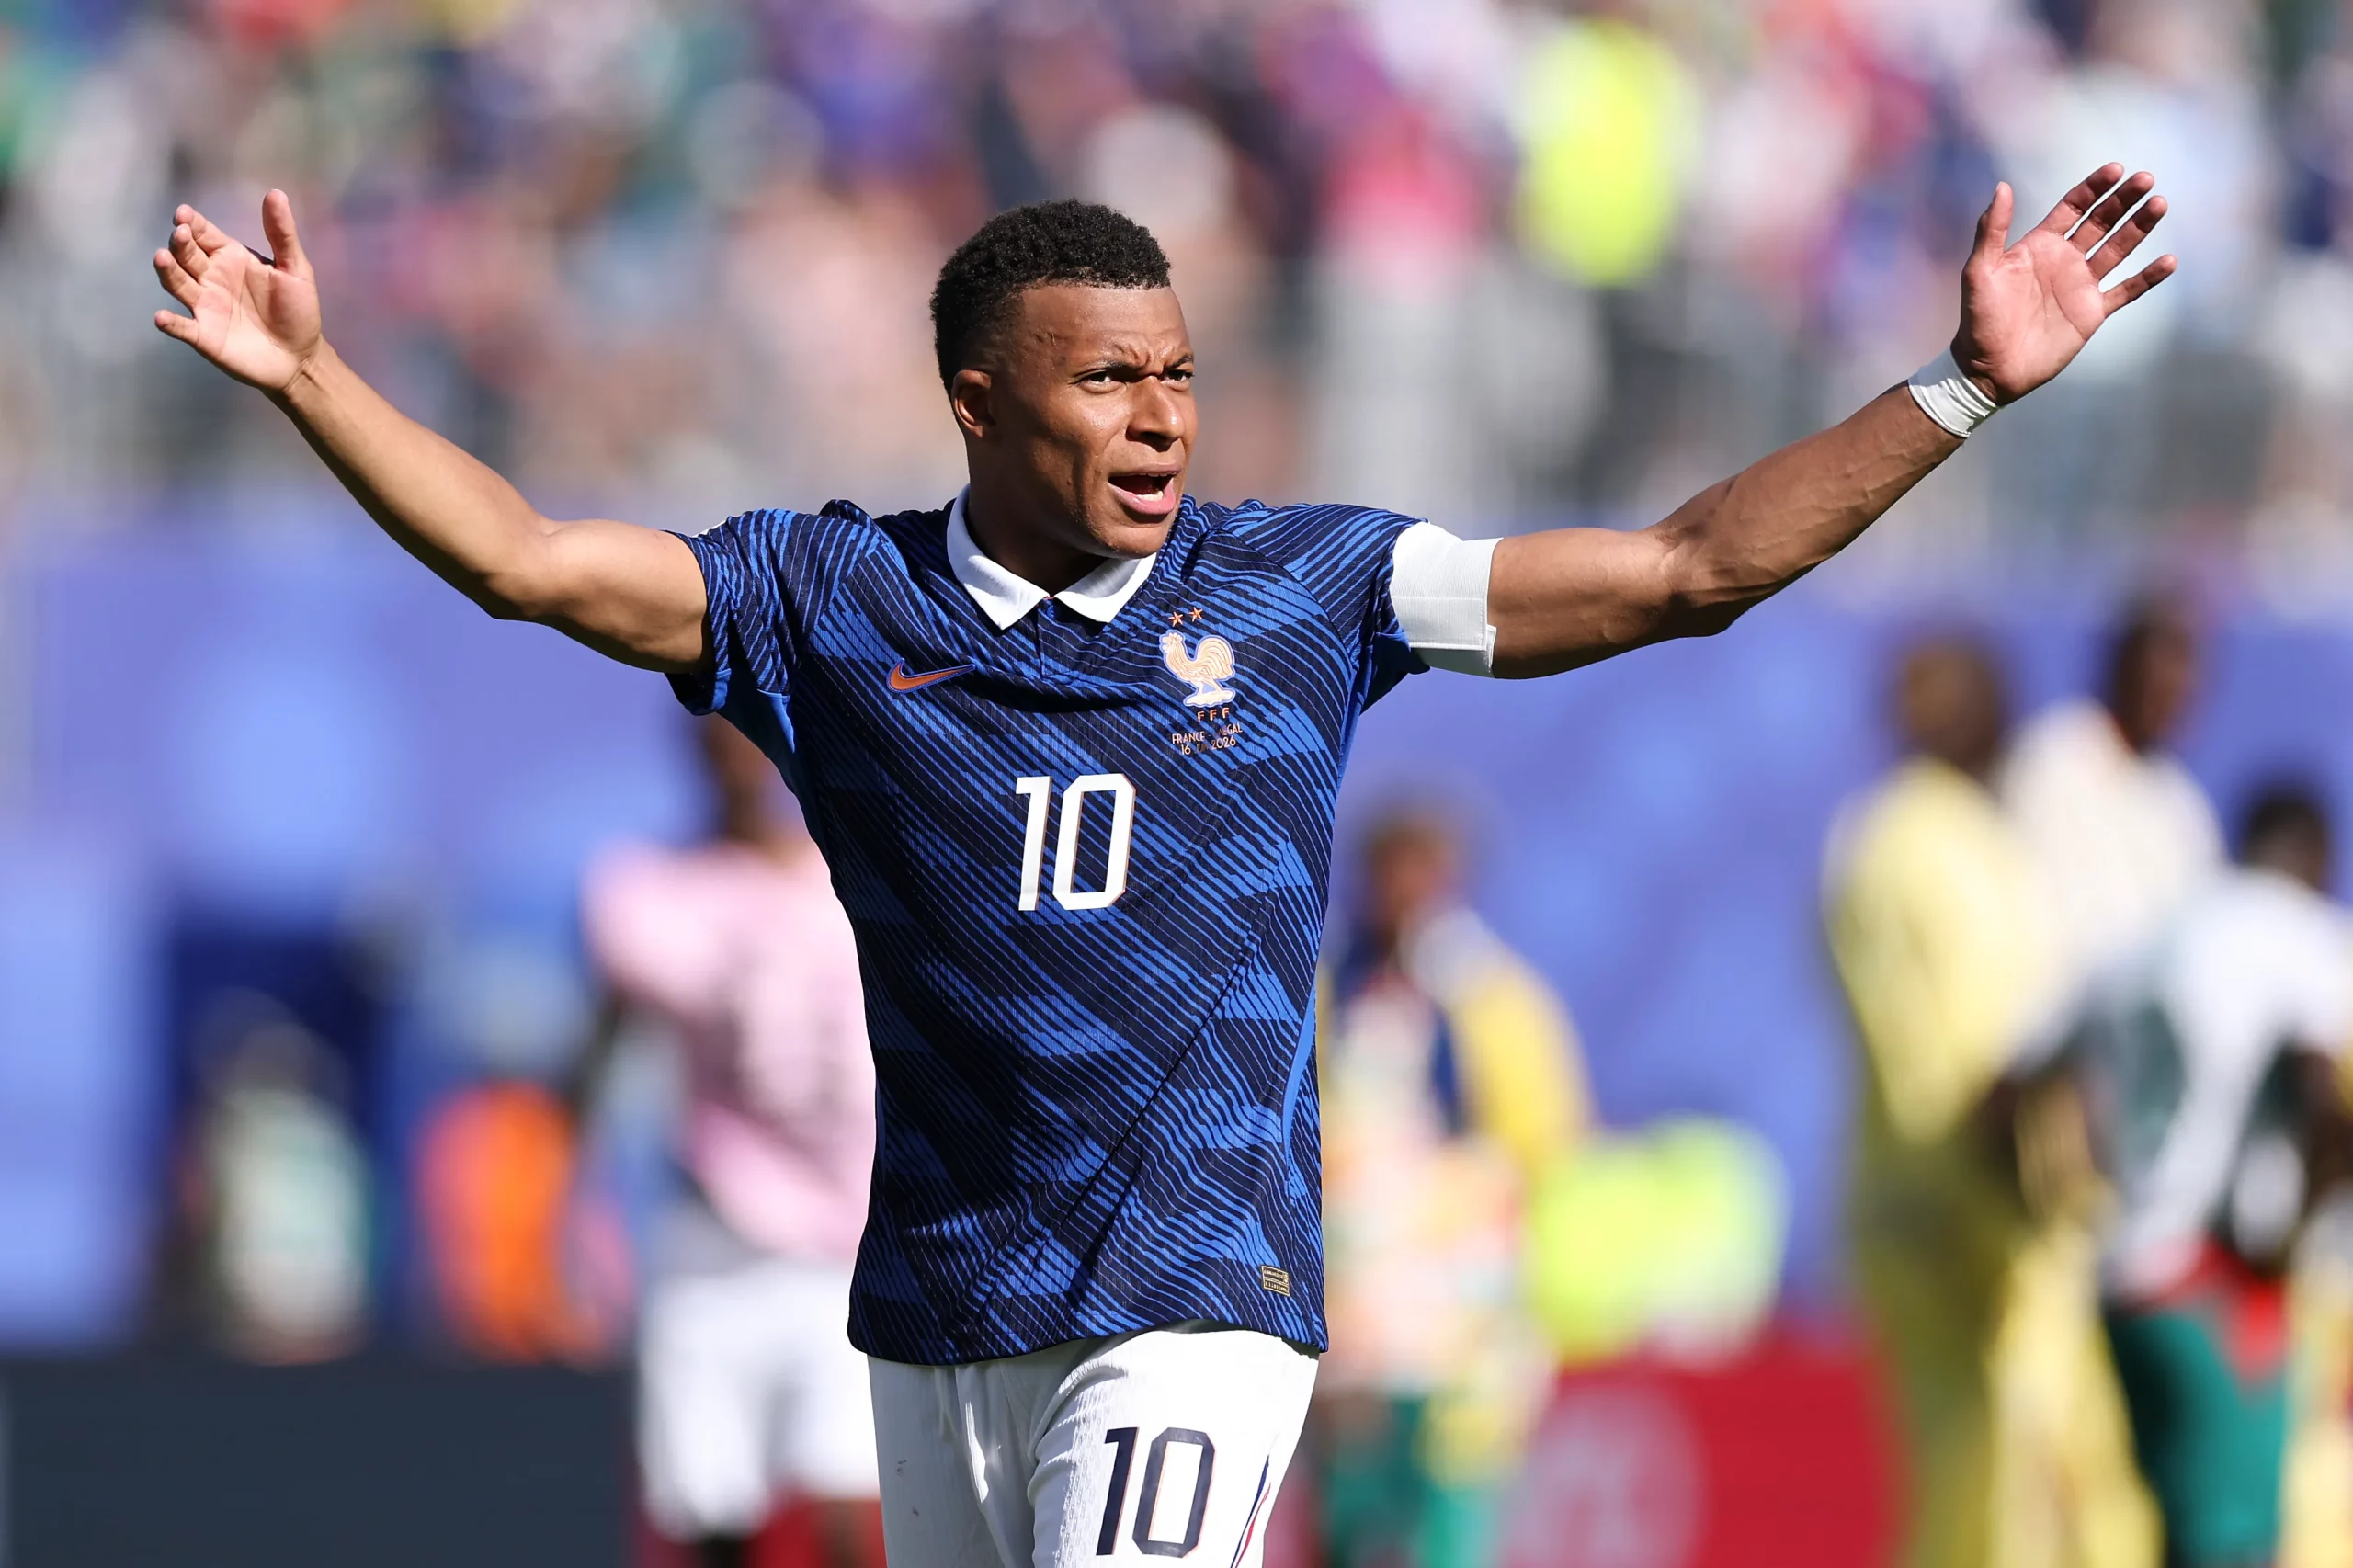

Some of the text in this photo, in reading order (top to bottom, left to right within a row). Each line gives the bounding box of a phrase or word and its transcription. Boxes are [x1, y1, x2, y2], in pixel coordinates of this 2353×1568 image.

[1172, 732, 1205, 744] FRANCE
[1181, 744, 1191, 755] 16
[1211, 735, 1236, 750] 2026
[1016, 773, 1136, 911] 10
[1096, 1426, 1215, 1559] 10
